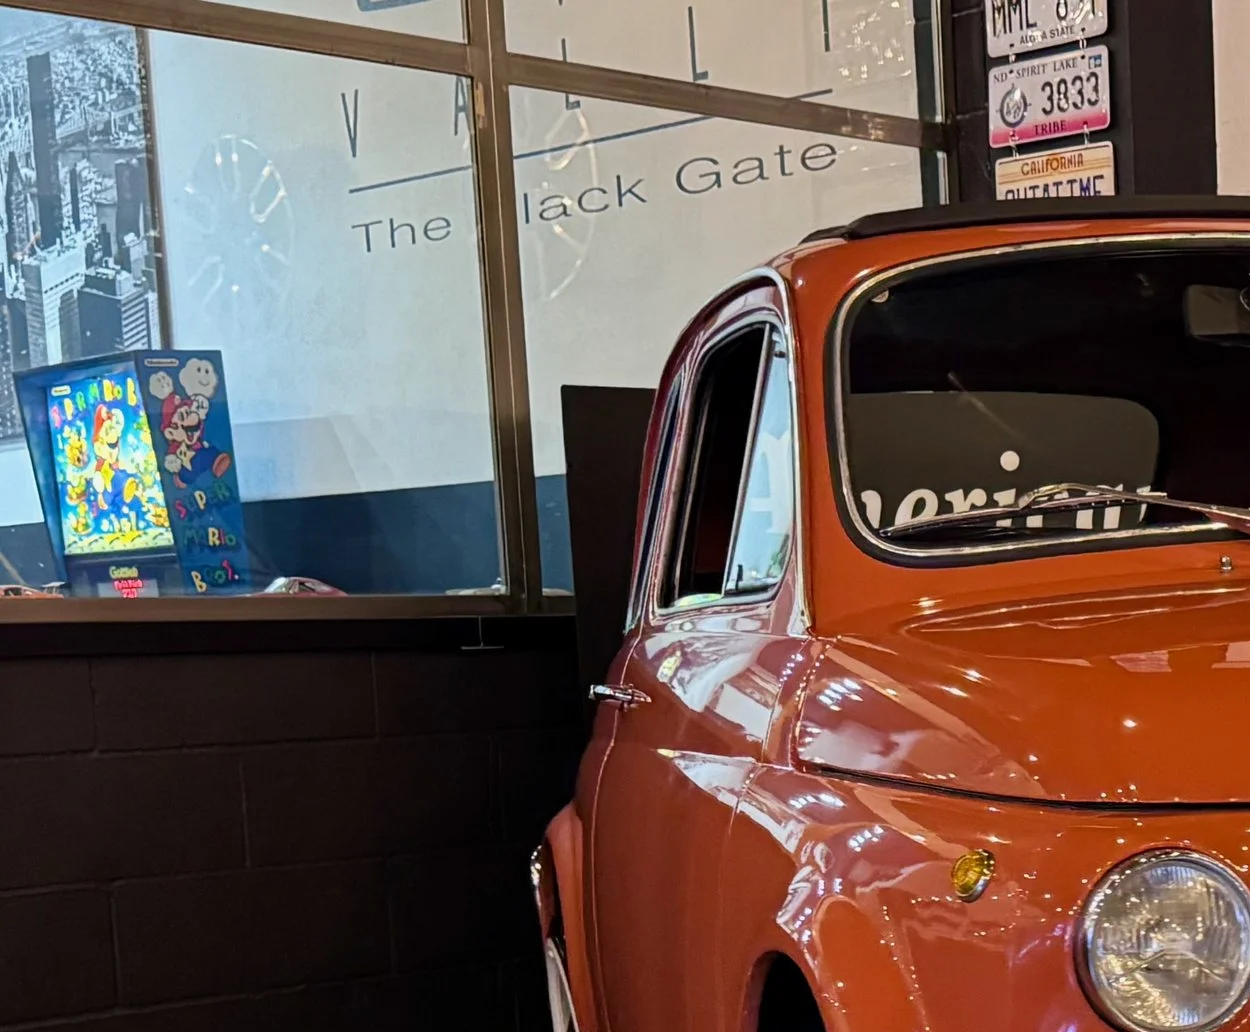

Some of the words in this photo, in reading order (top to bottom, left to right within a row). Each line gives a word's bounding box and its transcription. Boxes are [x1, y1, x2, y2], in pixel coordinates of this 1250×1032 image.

[1020, 30, 1047, 44] ALOA
[1050, 25, 1075, 39] STATE
[993, 73, 1008, 84] ND
[1016, 64, 1047, 79] SPIRIT
[1053, 57, 1078, 72] LAKE
[1041, 71, 1100, 116] 3833
[1033, 120, 1068, 136] TRIBE
[1020, 153, 1085, 177] CALIFORNIA
[351, 216, 452, 253] The
[522, 174, 648, 225] lack
[675, 142, 838, 195] Gate
